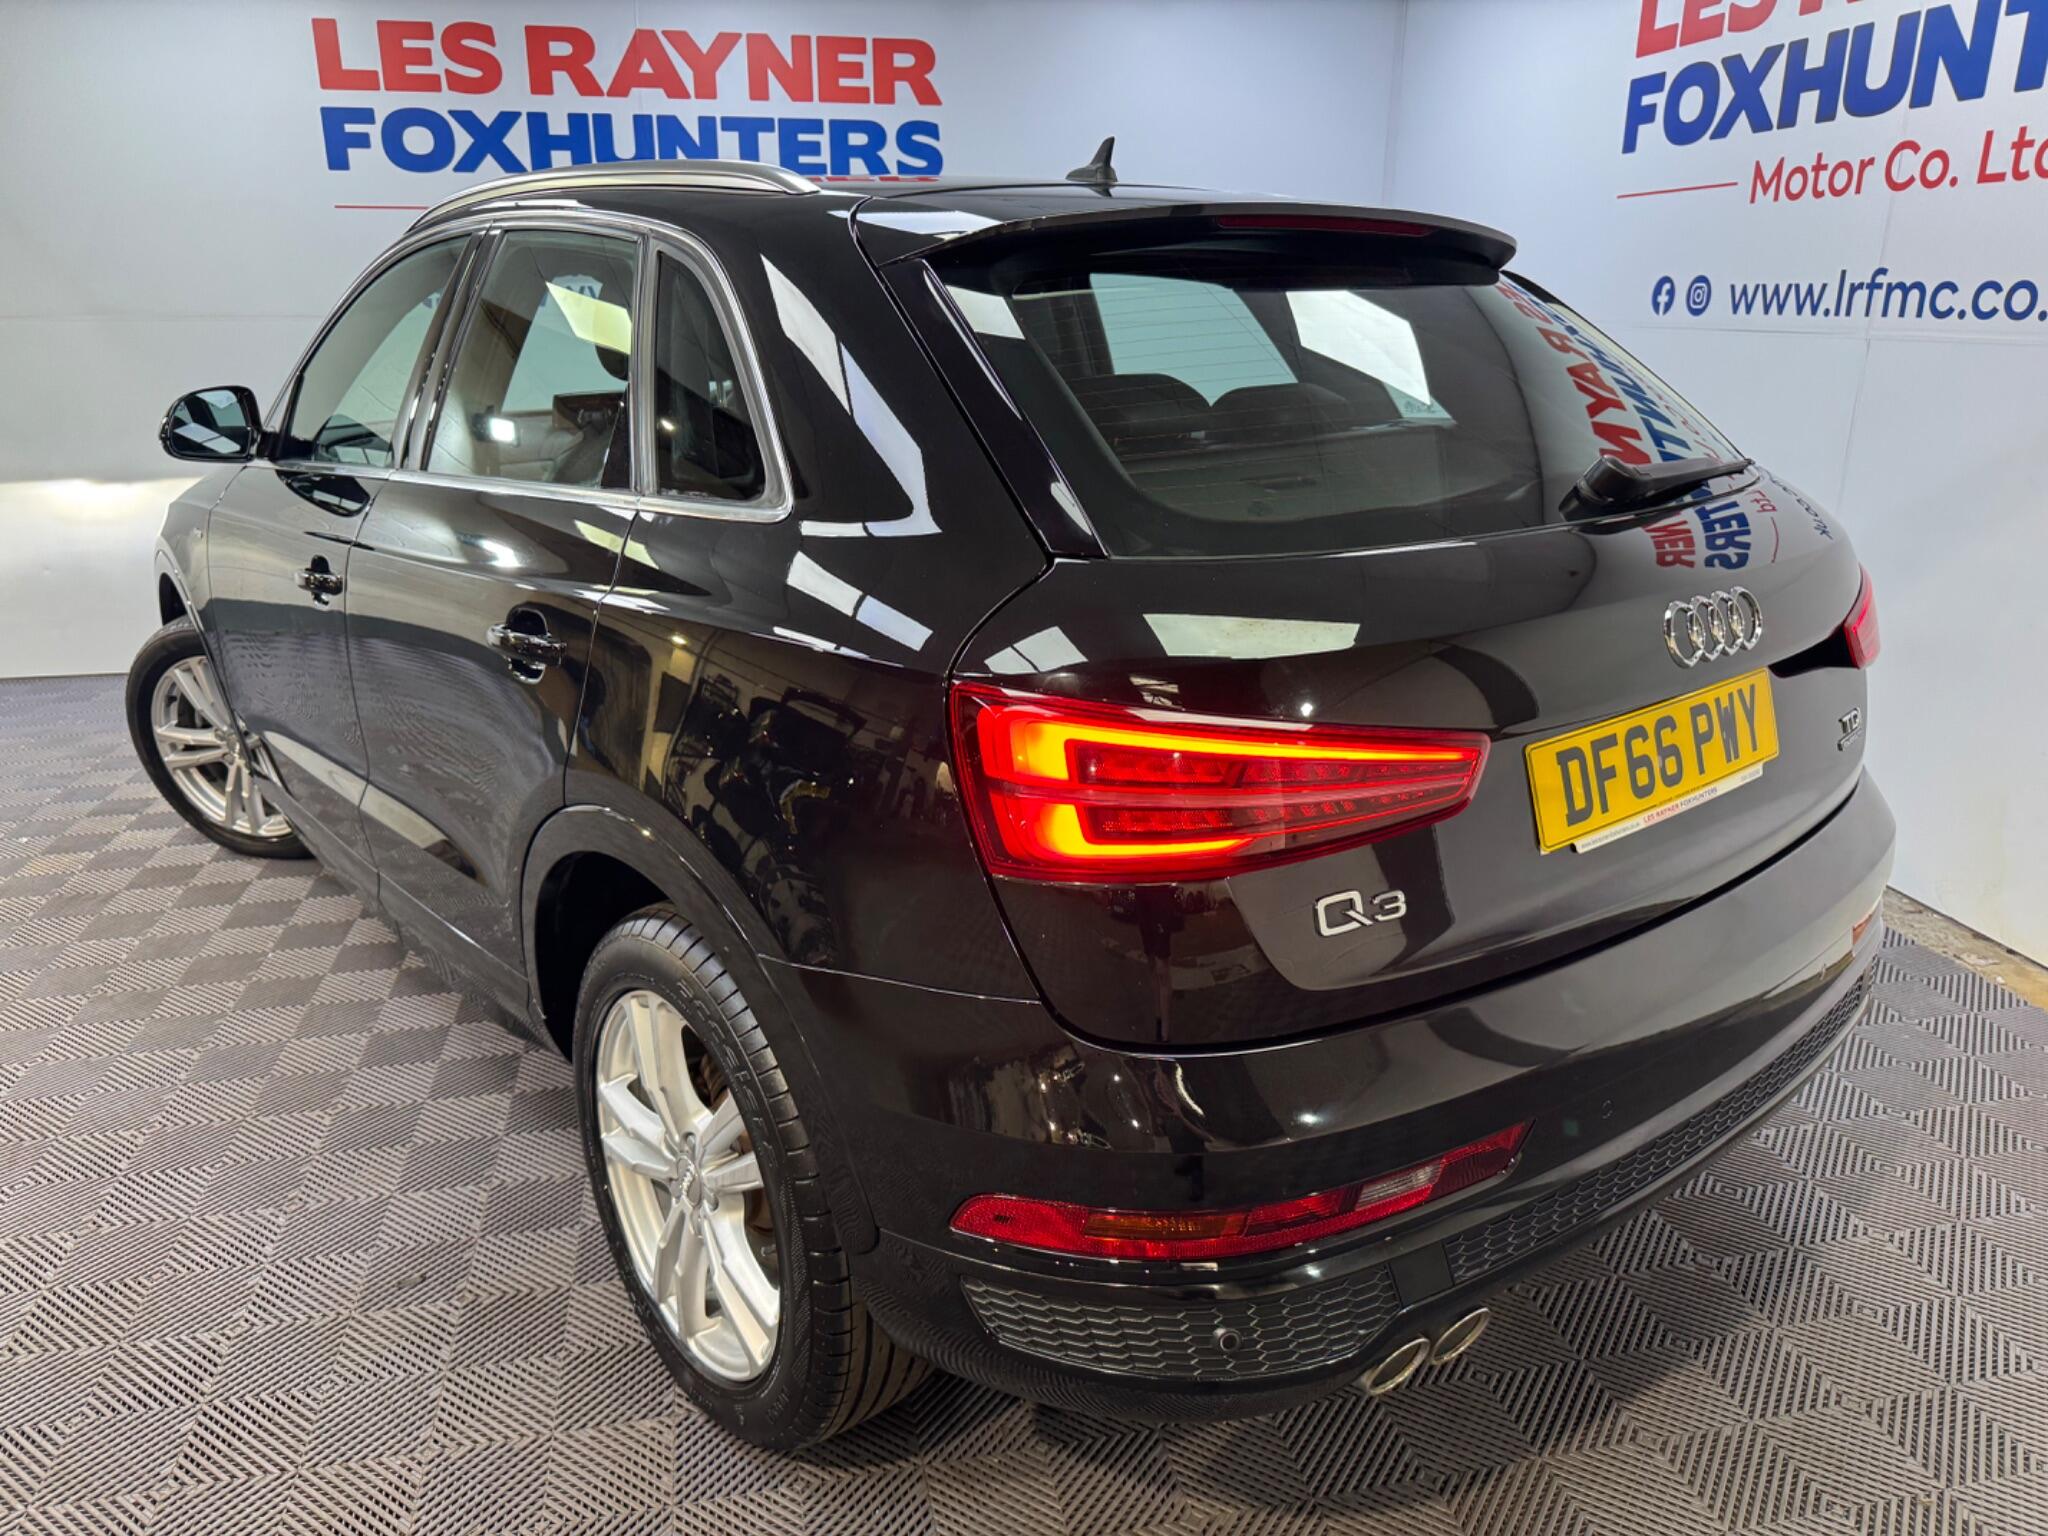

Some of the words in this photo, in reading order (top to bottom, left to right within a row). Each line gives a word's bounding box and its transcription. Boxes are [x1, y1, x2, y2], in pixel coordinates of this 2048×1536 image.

[312, 18, 503, 95] LES
[524, 25, 942, 106] RAYNER
[1621, 0, 2048, 154] FOXHUNT
[320, 106, 944, 177] FOXHUNTERS
[1750, 152, 1875, 204] Motor
[1884, 139, 1959, 193] Co.
[1555, 715, 1684, 827] DF66
[1689, 683, 1758, 775] PWY
[1314, 889, 1407, 937] Q3
